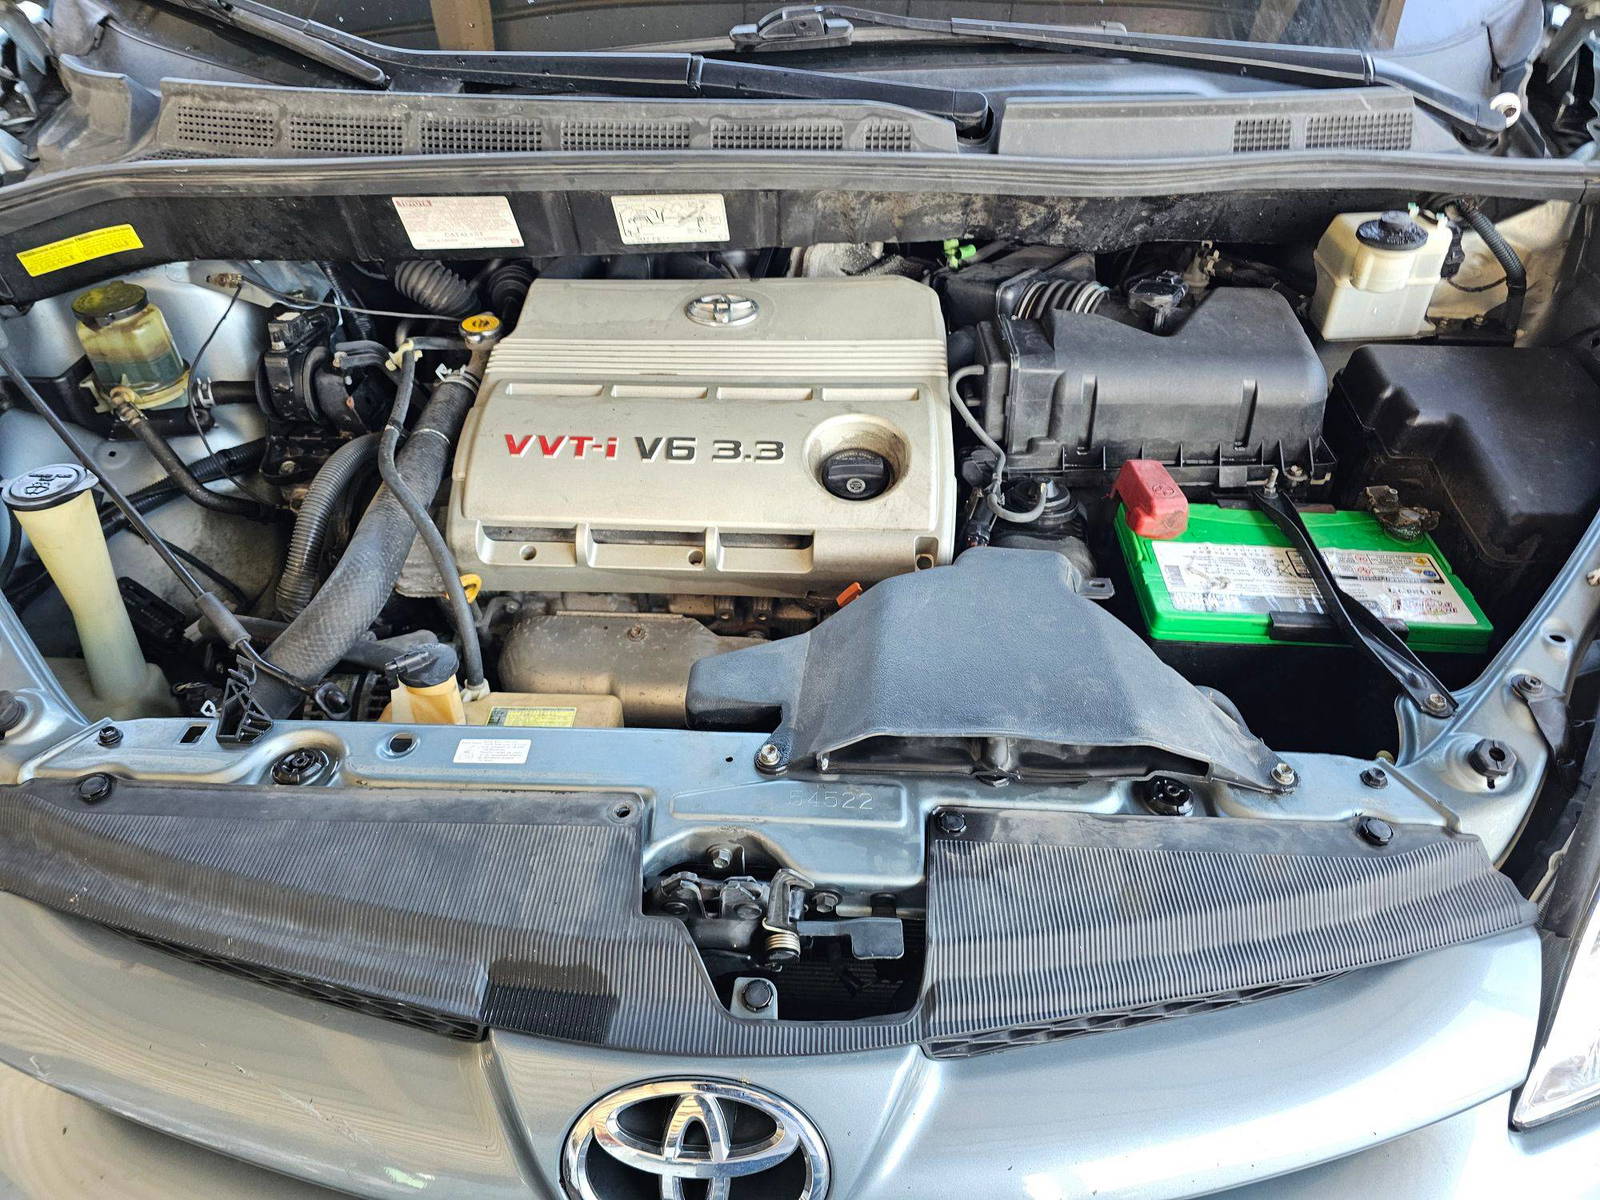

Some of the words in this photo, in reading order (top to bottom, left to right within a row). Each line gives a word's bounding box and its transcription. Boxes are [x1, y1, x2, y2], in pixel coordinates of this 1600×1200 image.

[504, 434, 618, 460] VVT-i
[633, 436, 697, 464] V6
[711, 439, 786, 464] 3.3
[789, 789, 873, 810] 54522
